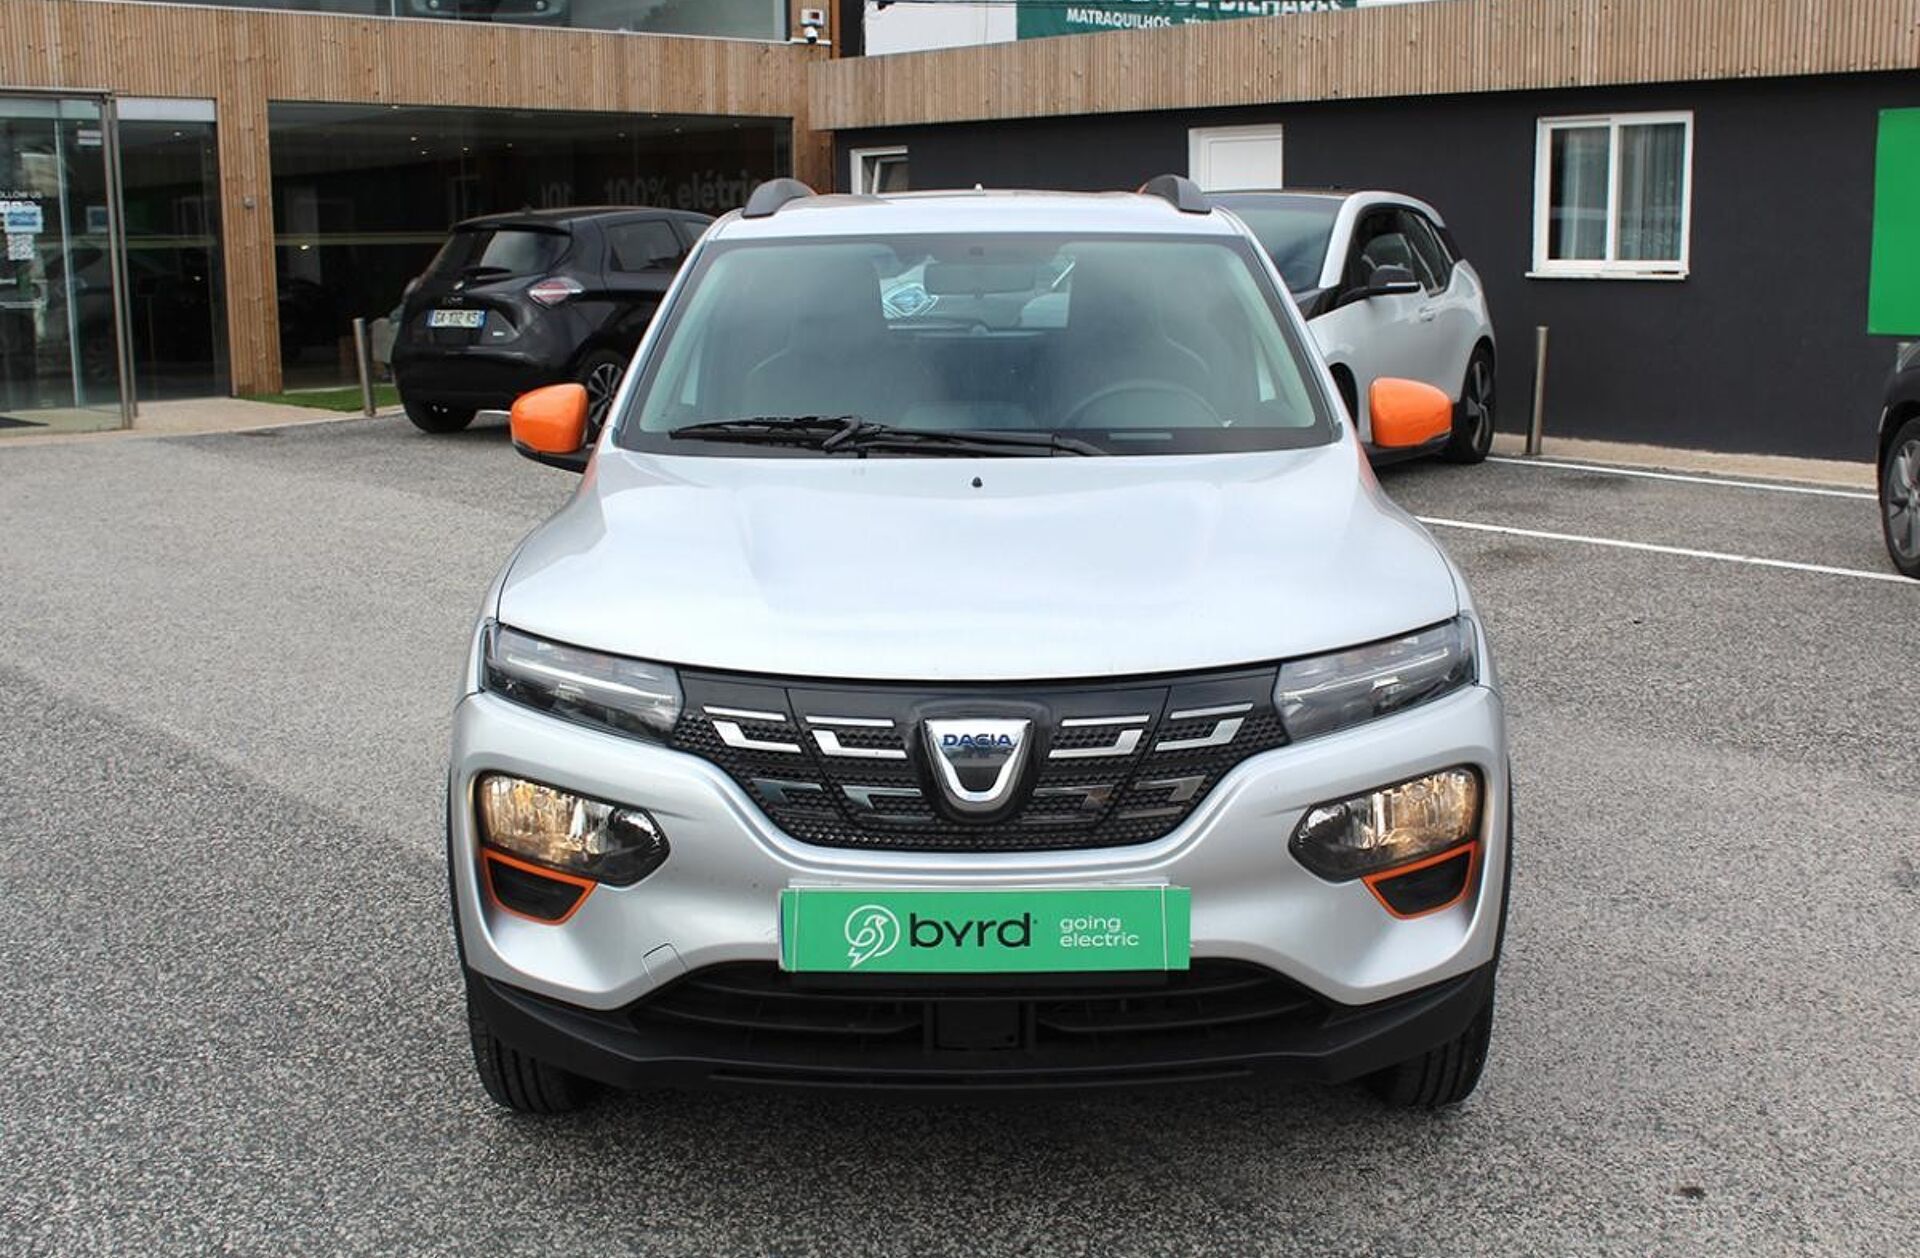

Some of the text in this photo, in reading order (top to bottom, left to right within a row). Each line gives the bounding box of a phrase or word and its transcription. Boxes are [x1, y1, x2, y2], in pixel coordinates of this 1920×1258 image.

[942, 733, 1012, 747] DACIA
[909, 912, 1031, 948] byrd
[1060, 916, 1121, 934] going
[1060, 932, 1139, 947] electric
